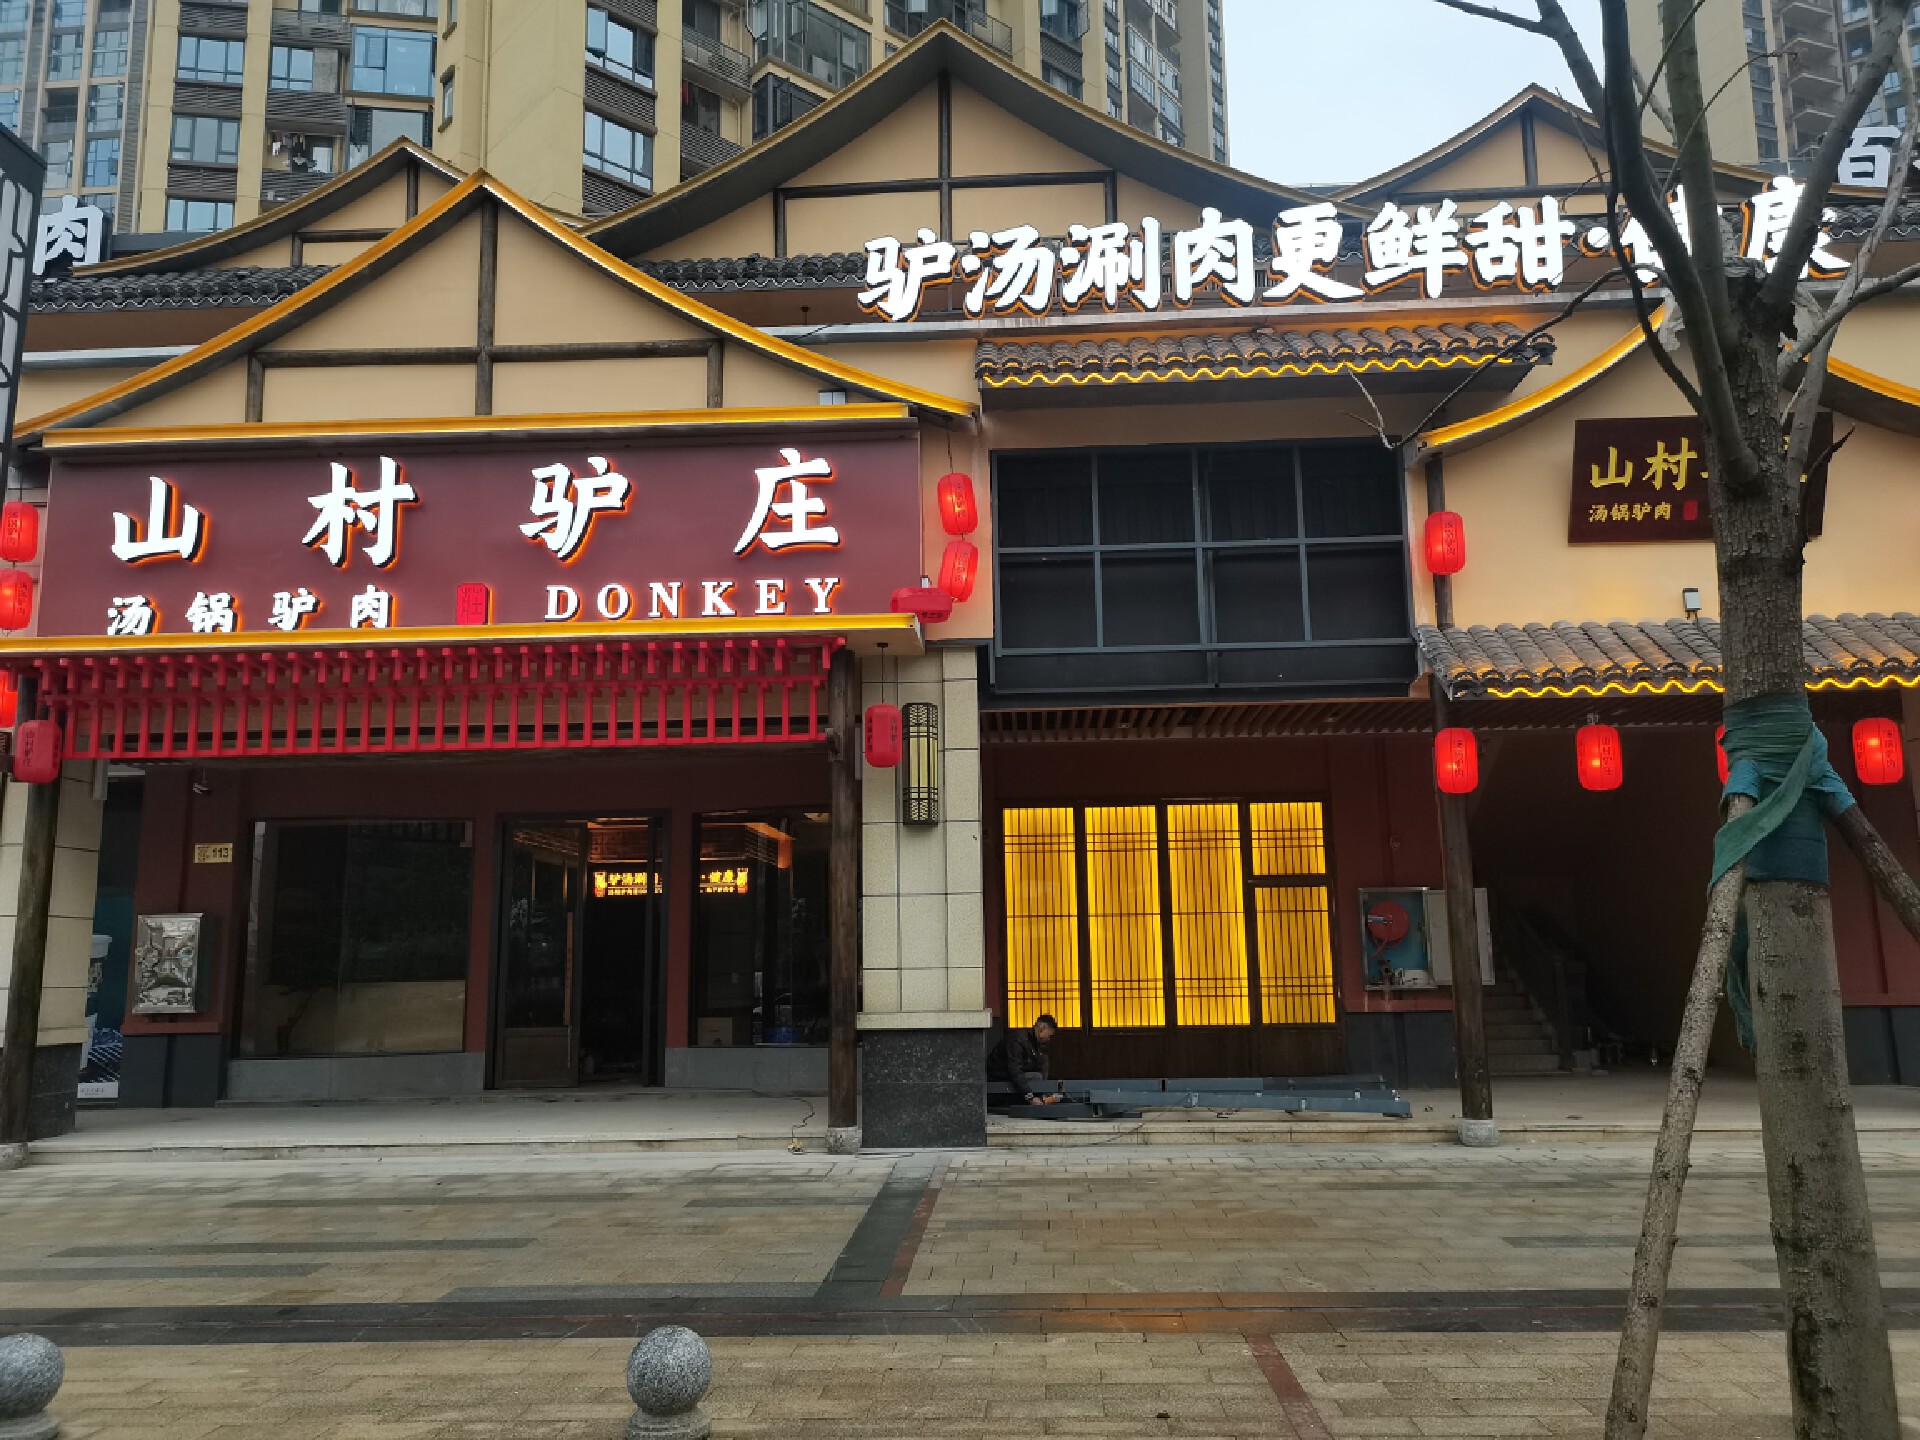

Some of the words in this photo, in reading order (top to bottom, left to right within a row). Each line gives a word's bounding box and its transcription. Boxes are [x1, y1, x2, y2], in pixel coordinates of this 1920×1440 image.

[1837, 125, 1902, 188] 百
[32, 195, 103, 276] 肉
[110, 447, 842, 568] 山村驴庄
[1588, 501, 1671, 522] 汤锅驴肉
[107, 583, 391, 636] 汤锅驴肉
[544, 577, 840, 620] DONKEY
